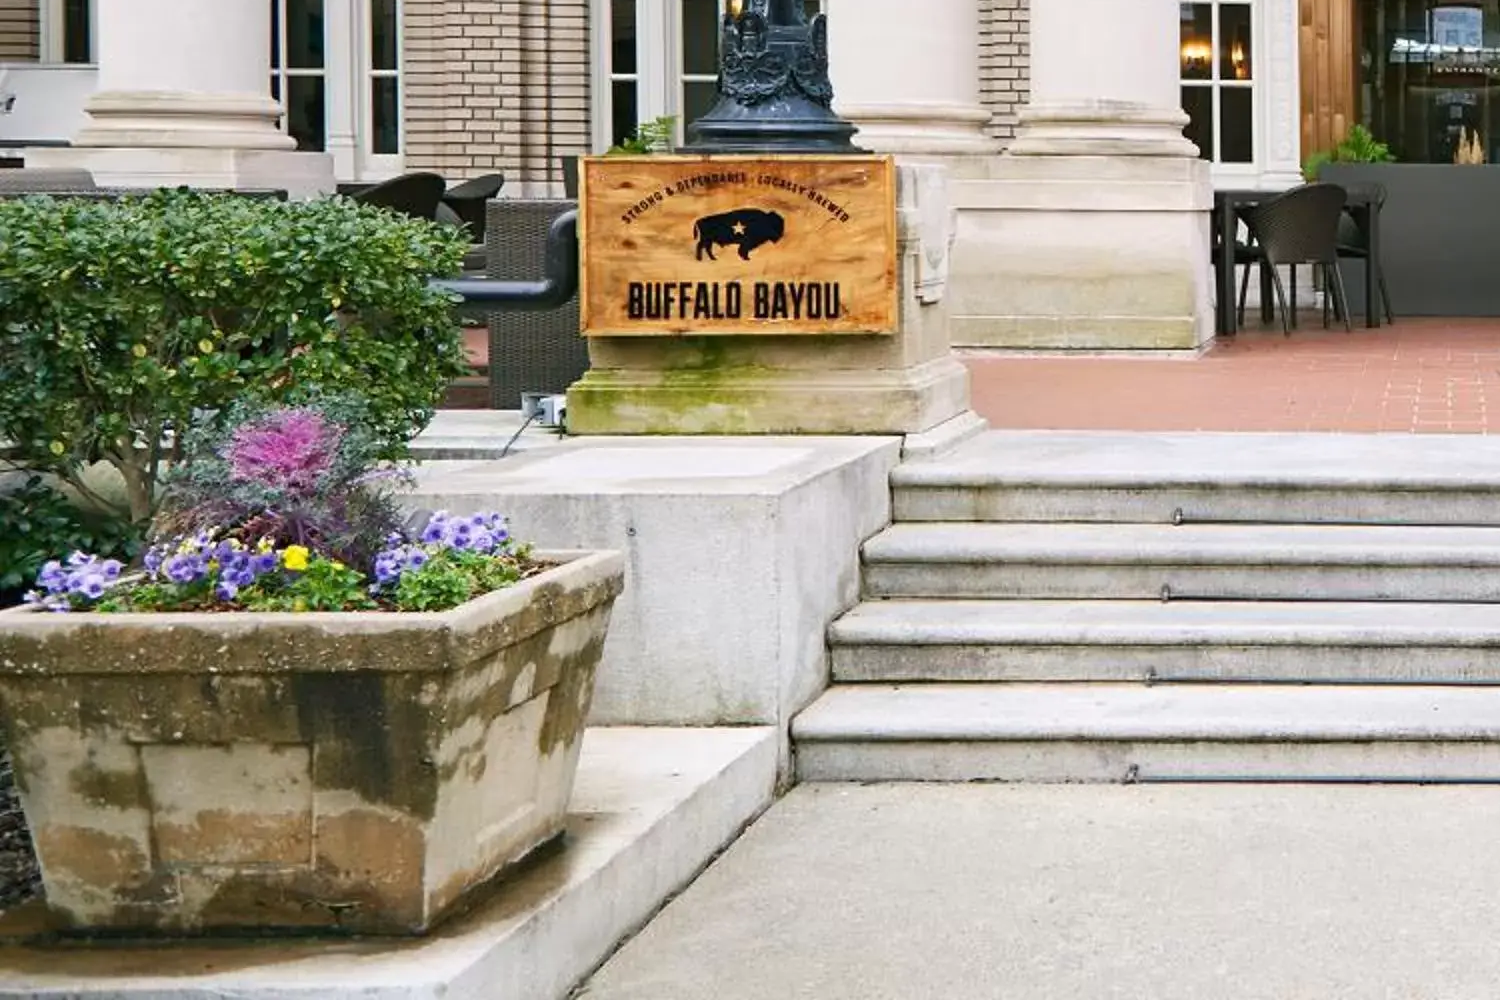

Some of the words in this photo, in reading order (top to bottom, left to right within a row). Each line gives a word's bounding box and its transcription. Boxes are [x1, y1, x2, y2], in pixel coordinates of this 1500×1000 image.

[621, 191, 664, 224] STRONG
[665, 186, 675, 197] &
[676, 171, 746, 193] DEPENDABLE
[758, 175, 807, 195] LOCALLY
[807, 188, 850, 222] BREWED
[627, 281, 742, 321] BUFFALO
[753, 281, 841, 321] BAYOU
